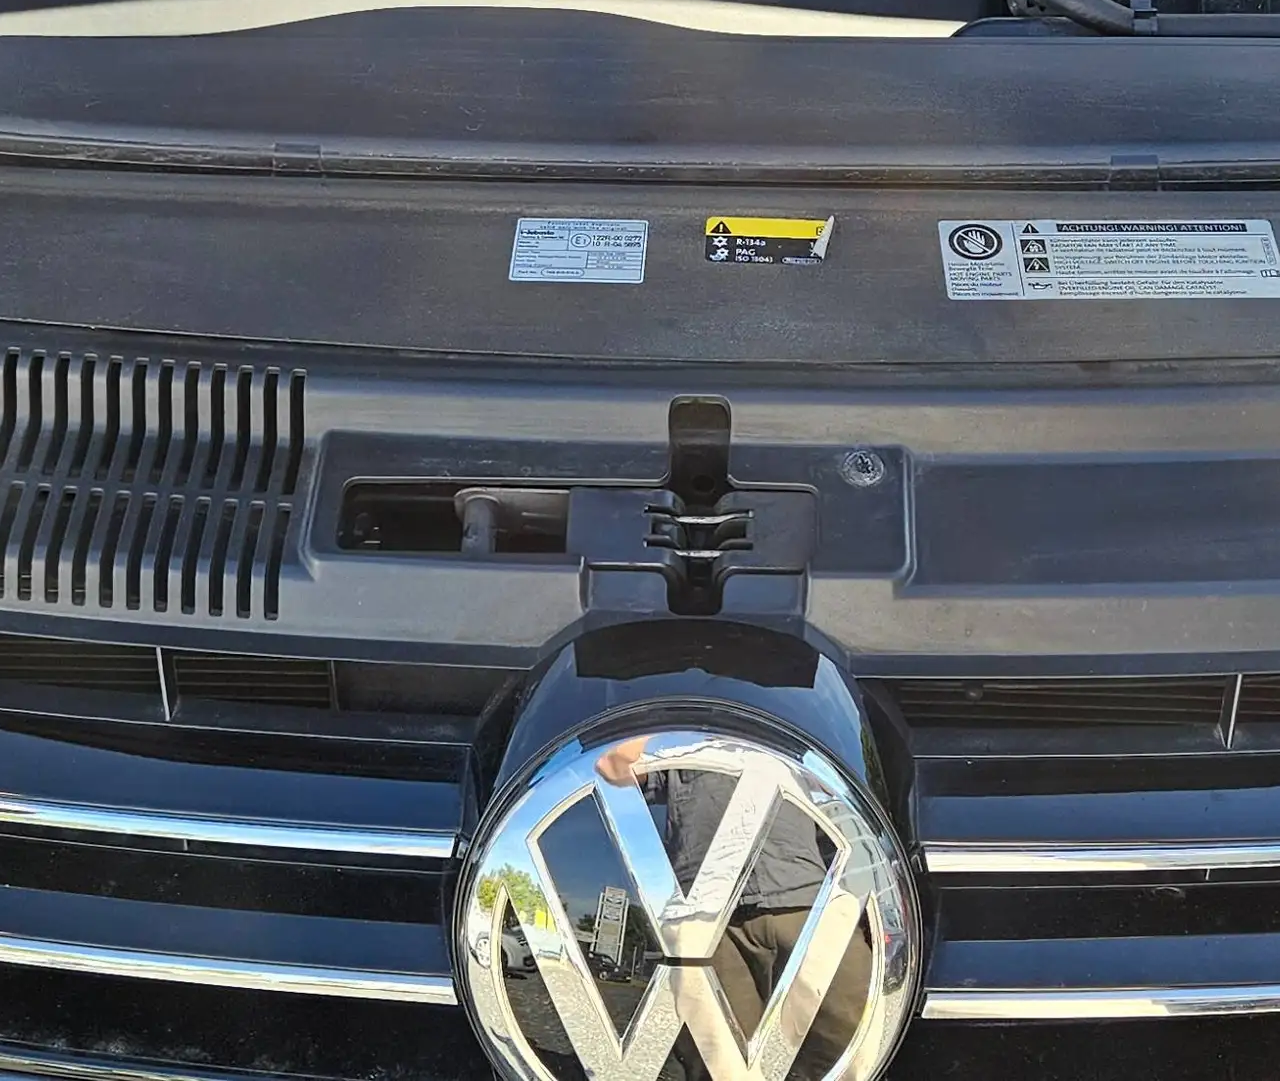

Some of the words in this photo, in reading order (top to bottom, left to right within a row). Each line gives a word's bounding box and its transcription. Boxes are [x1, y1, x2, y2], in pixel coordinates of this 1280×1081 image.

[1062, 224, 1118, 232] ACHTUNG!
[1120, 224, 1178, 232] WARNING!
[735, 248, 756, 256] PAG
